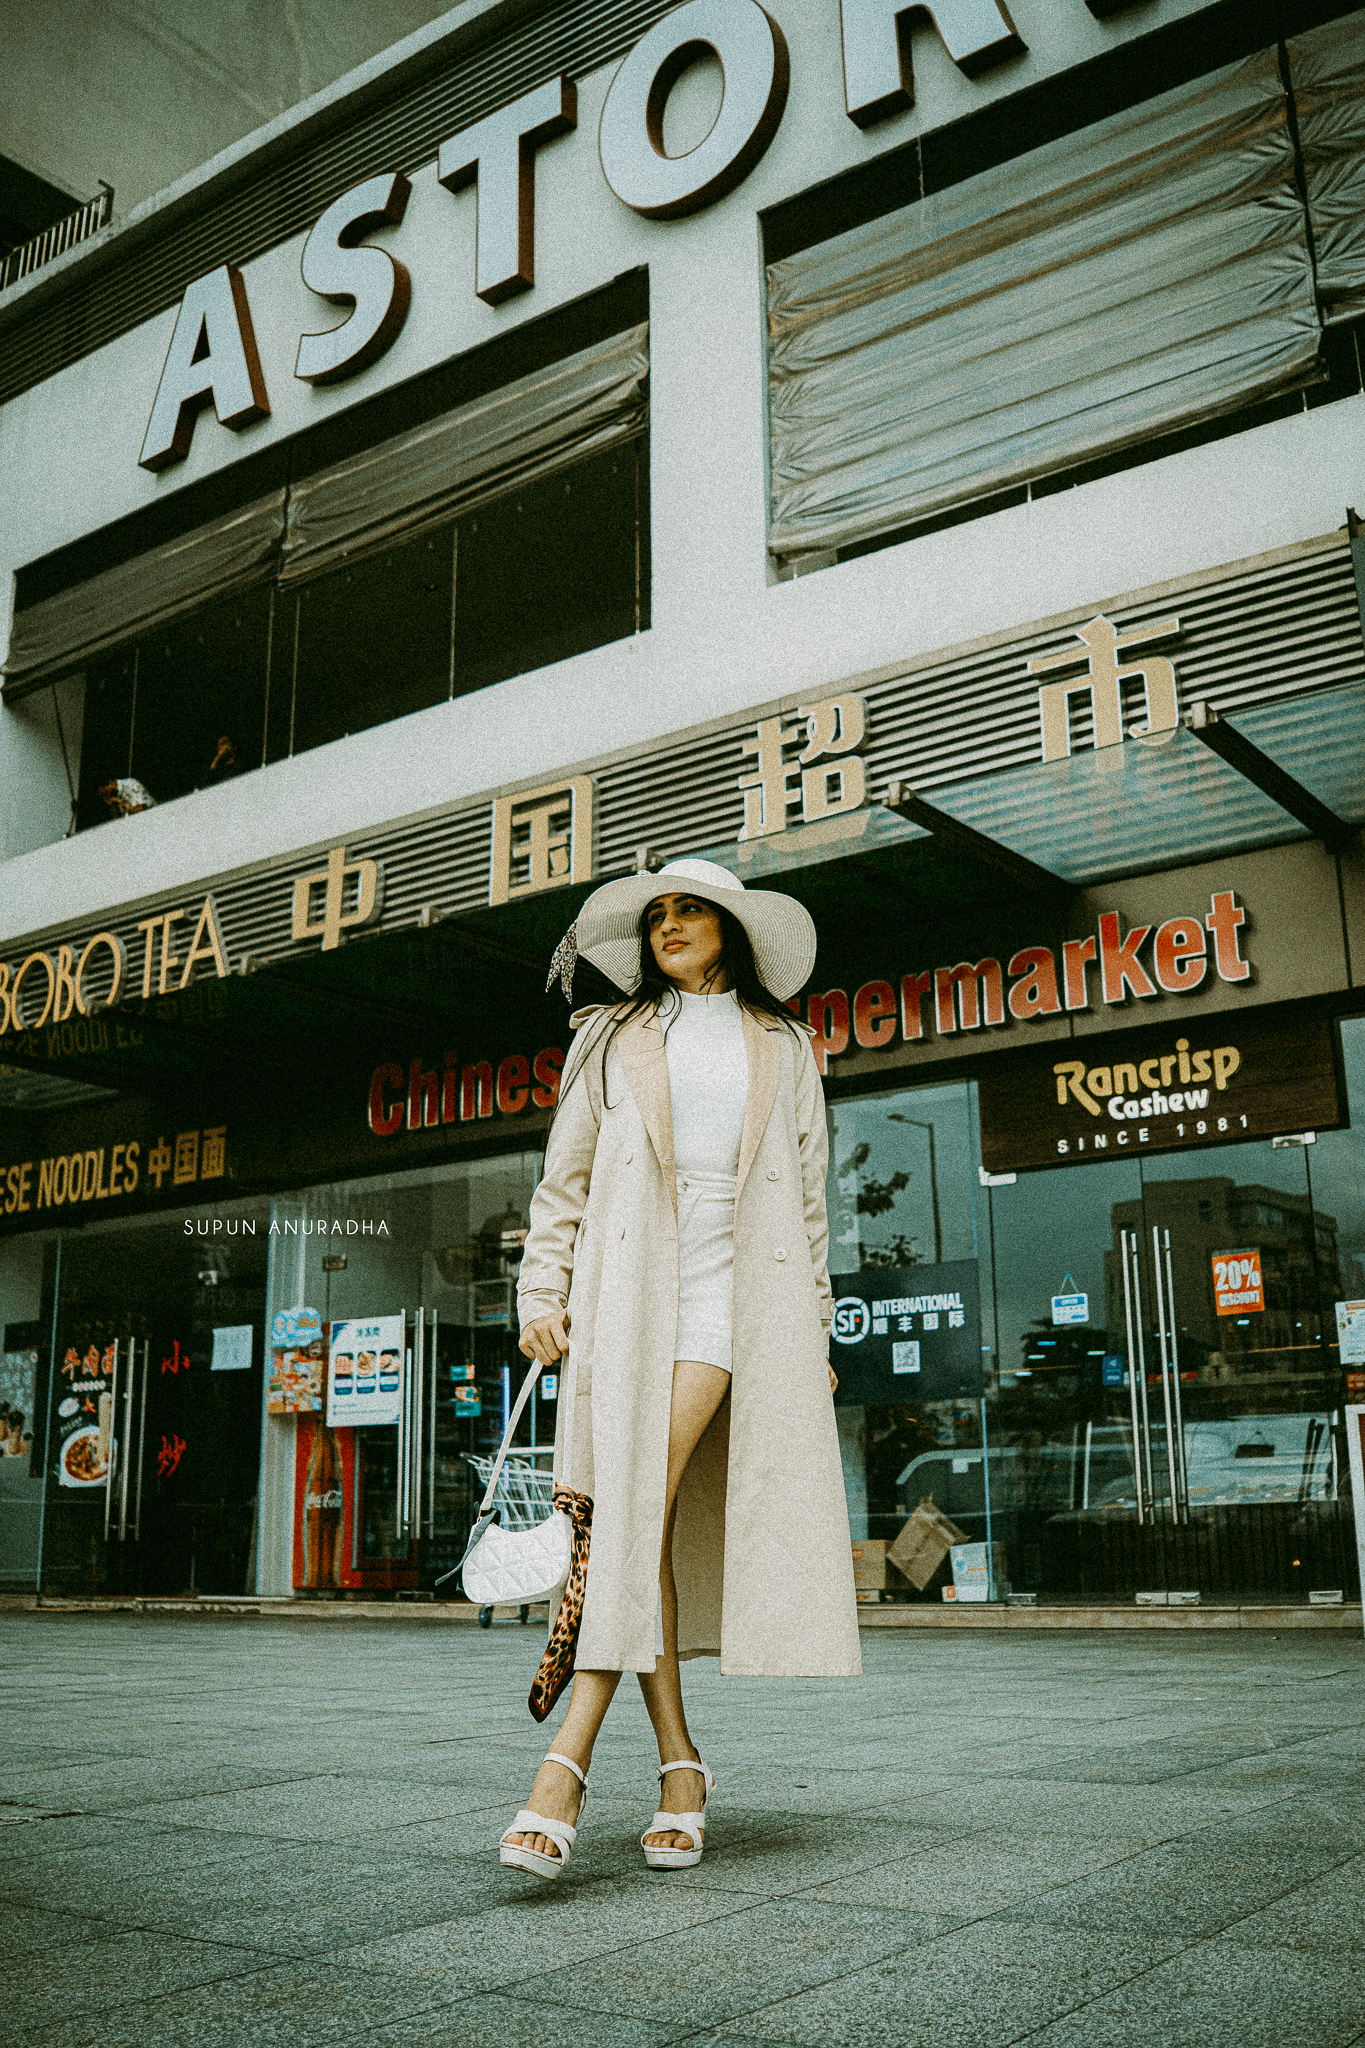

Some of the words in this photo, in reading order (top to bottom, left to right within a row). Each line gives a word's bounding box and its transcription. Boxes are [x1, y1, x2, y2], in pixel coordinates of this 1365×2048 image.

[137, 0, 1172, 473] ASTO
[137, 897, 228, 999] TEA
[368, 1048, 566, 1136] Chines
[792, 890, 1251, 1076] permarket
[1053, 1037, 1241, 1117] Rancrisp
[1107, 1088, 1209, 1121] Cashew
[1057, 1127, 1150, 1154] SINCE
[1176, 1114, 1249, 1138] 1981
[37, 1141, 140, 1209] NOODLES
[872, 1292, 965, 1318] INTERNATIONAL
[1214, 1258, 1261, 1292] 20%
